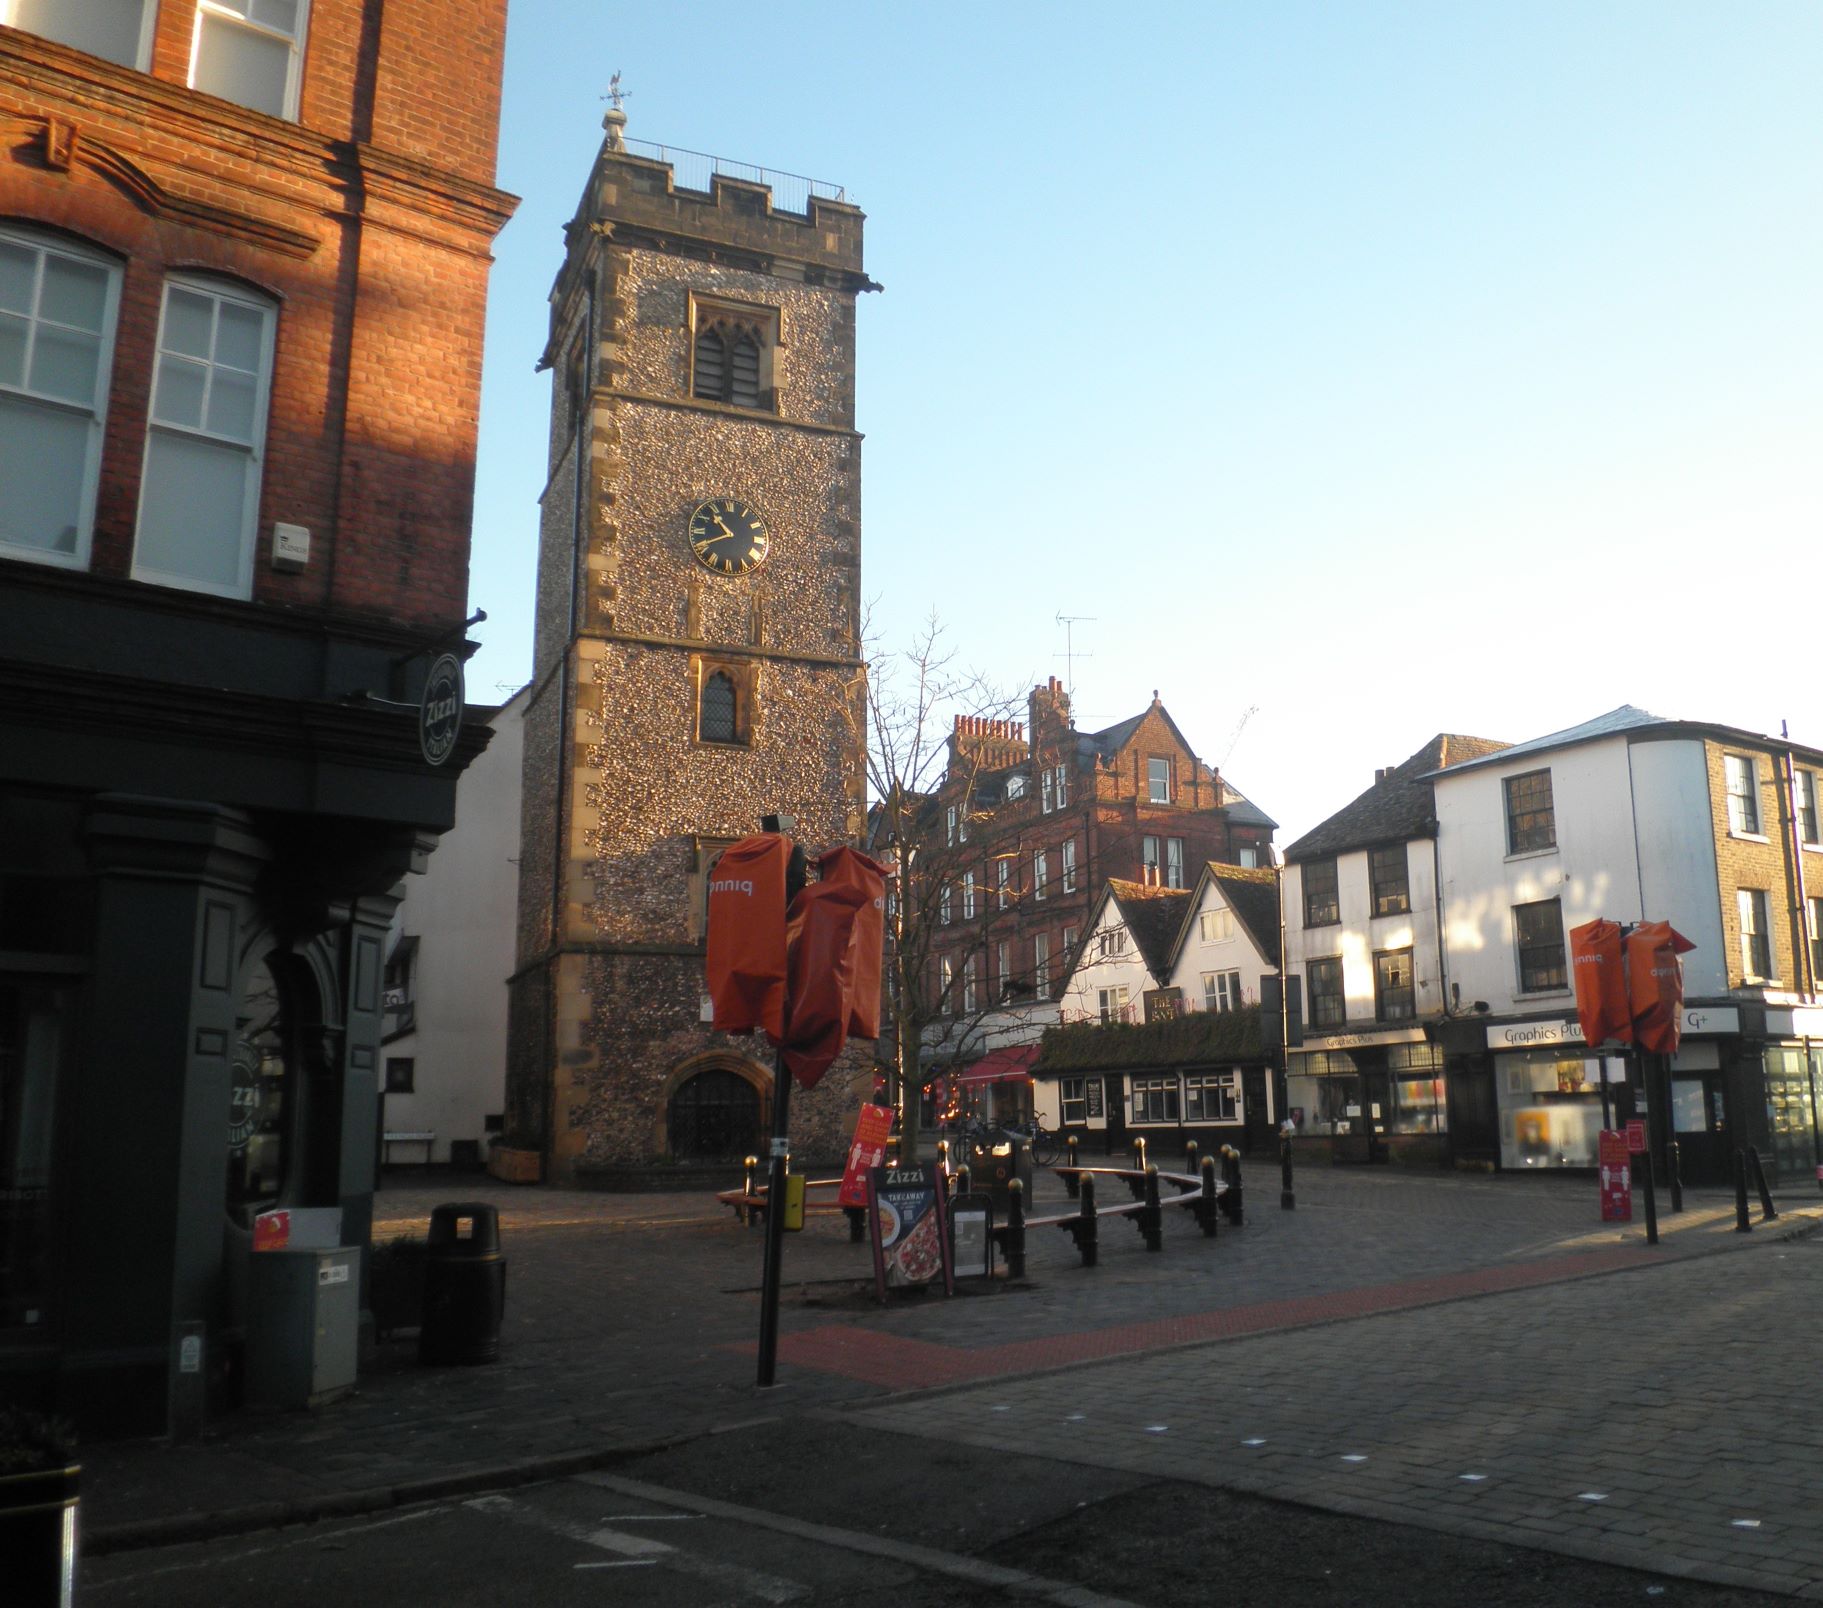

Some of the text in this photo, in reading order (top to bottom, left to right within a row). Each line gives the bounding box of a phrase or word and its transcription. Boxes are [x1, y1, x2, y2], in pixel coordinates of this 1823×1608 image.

[425, 692, 456, 727] Zizzi
[1687, 1012, 1708, 1029] G+
[1505, 1023, 1585, 1044] Graphics Plu
[886, 1168, 925, 1185] Zizzi
[888, 1191, 925, 1202] TAKEAWAY
